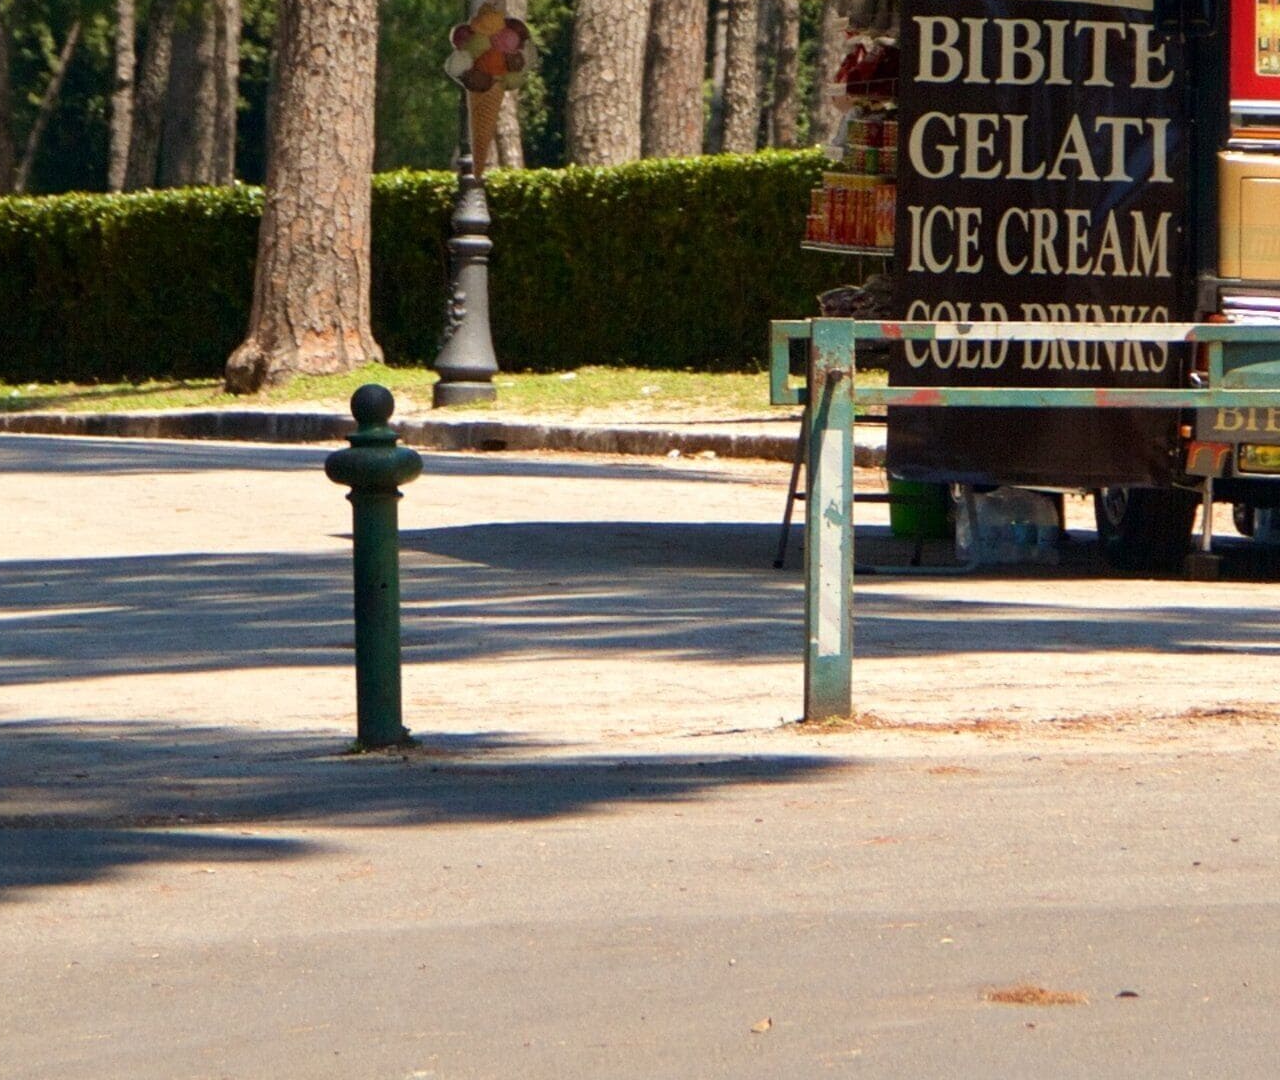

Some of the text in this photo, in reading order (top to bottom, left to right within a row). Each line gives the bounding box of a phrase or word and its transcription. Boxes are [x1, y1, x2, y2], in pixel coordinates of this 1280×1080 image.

[912, 14, 1175, 90] BIBITE
[908, 110, 1175, 184] GELATI
[906, 205, 1173, 279] ICE CREAM
[904, 299, 1170, 374] COLD DRINKS
